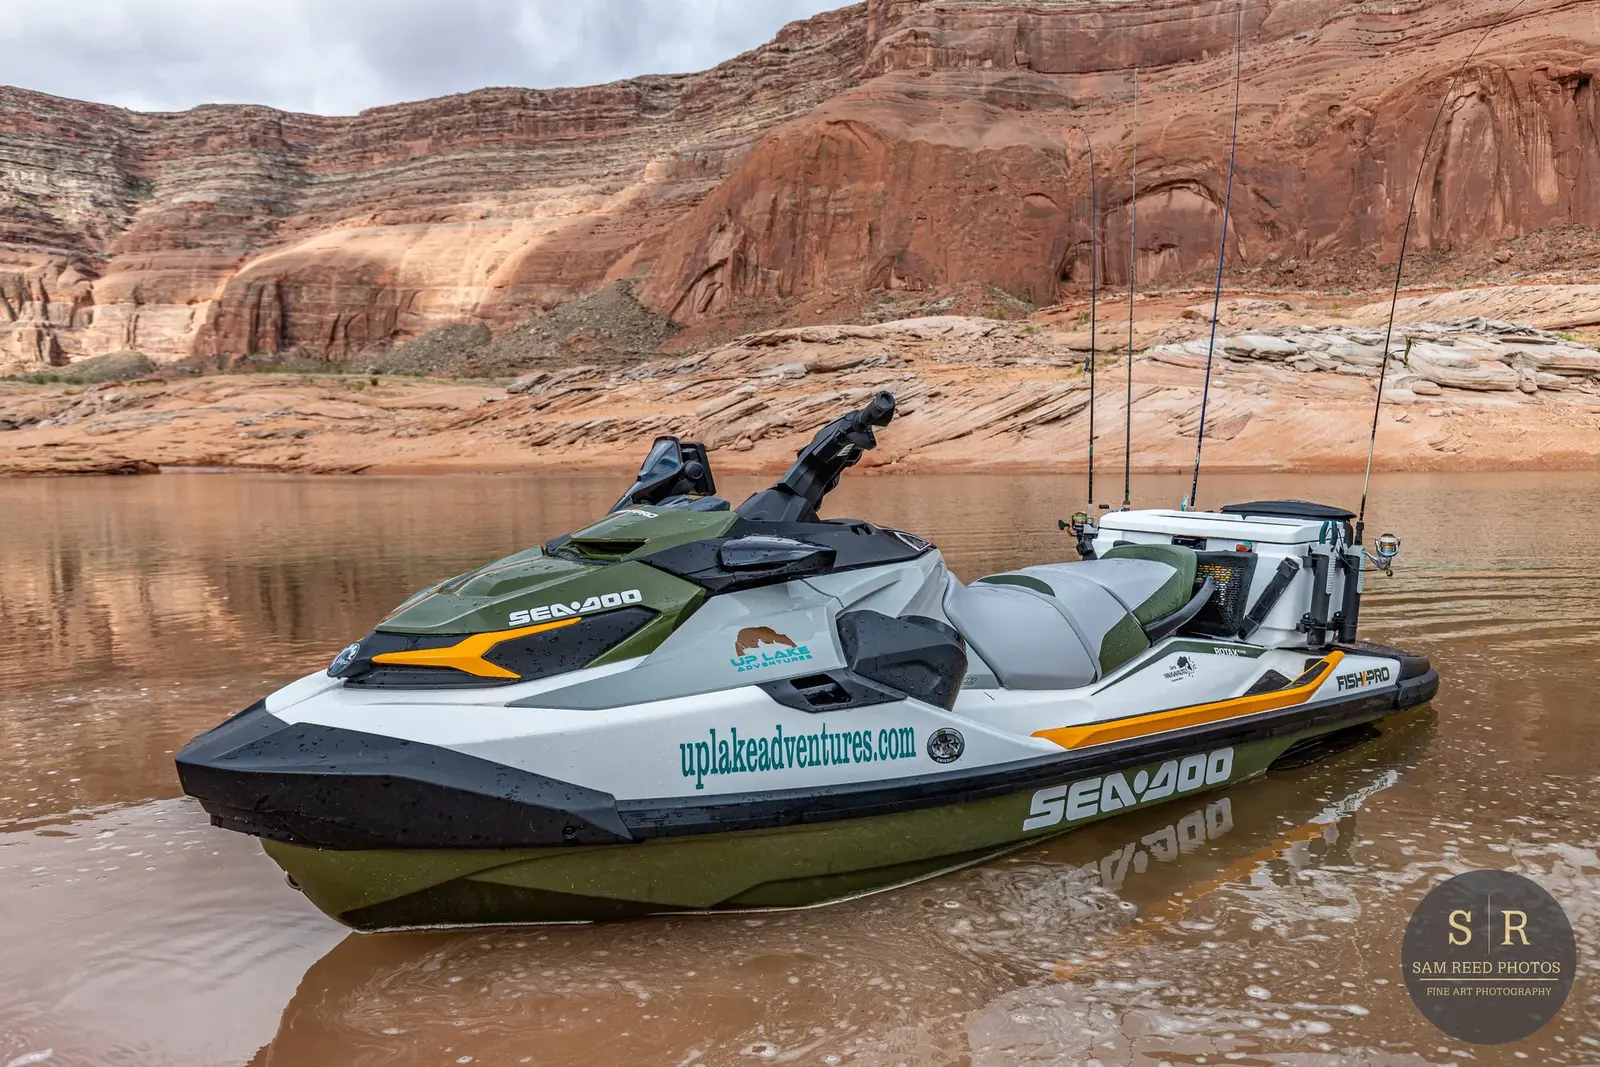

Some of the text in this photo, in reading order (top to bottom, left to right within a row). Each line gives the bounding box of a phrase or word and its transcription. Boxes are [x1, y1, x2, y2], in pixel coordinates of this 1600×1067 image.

[730, 645, 811, 667] UP LAKE
[1213, 647, 1239, 657] ROTAX
[737, 654, 813, 673] ADVENTURES
[679, 722, 917, 790] uplakeadventures.com
